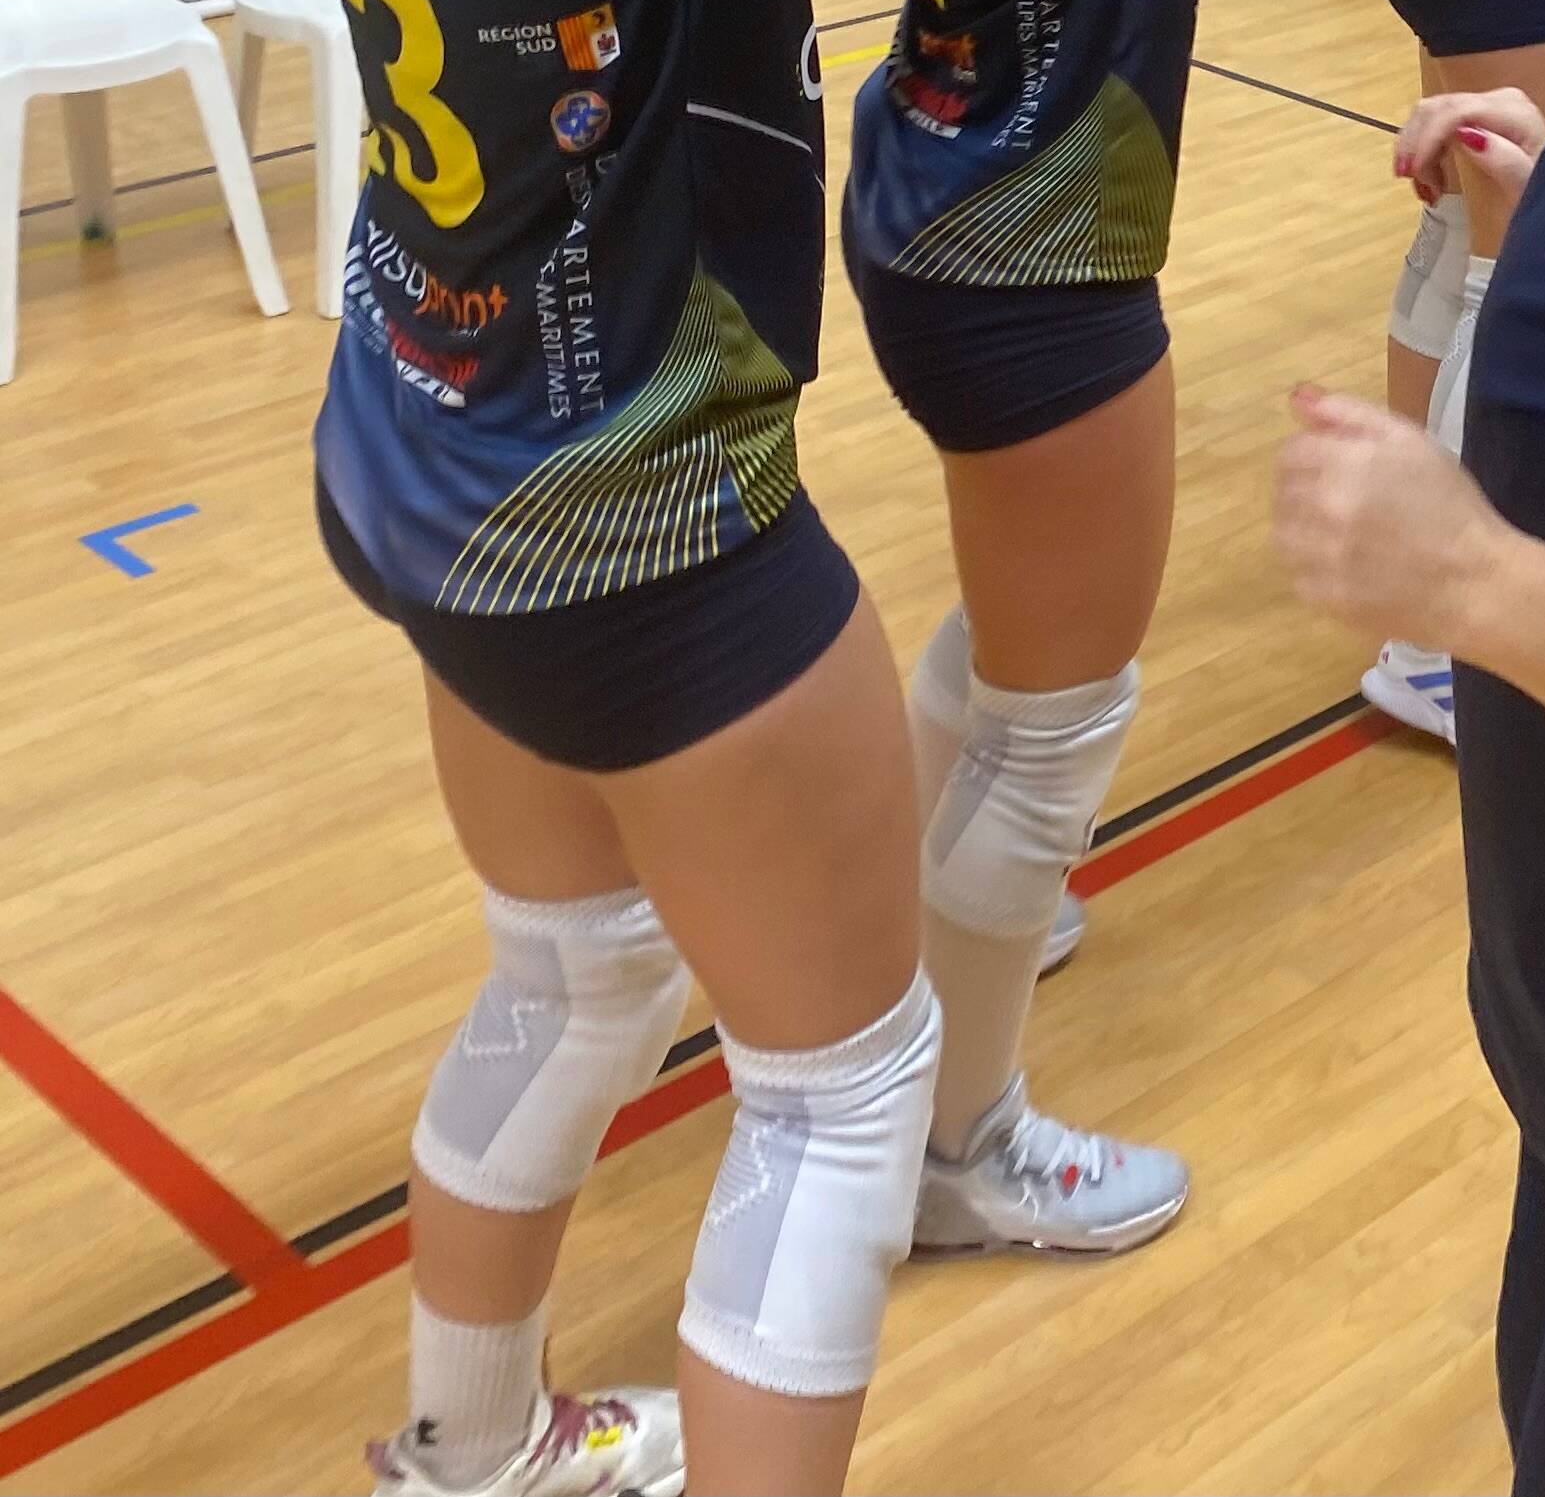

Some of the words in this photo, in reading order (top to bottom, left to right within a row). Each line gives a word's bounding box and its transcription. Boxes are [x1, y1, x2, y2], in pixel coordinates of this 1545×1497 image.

[515, 37, 557, 56] SUD
[991, 47, 1040, 150] MARIES
[536, 281, 571, 420] MARITIMES
